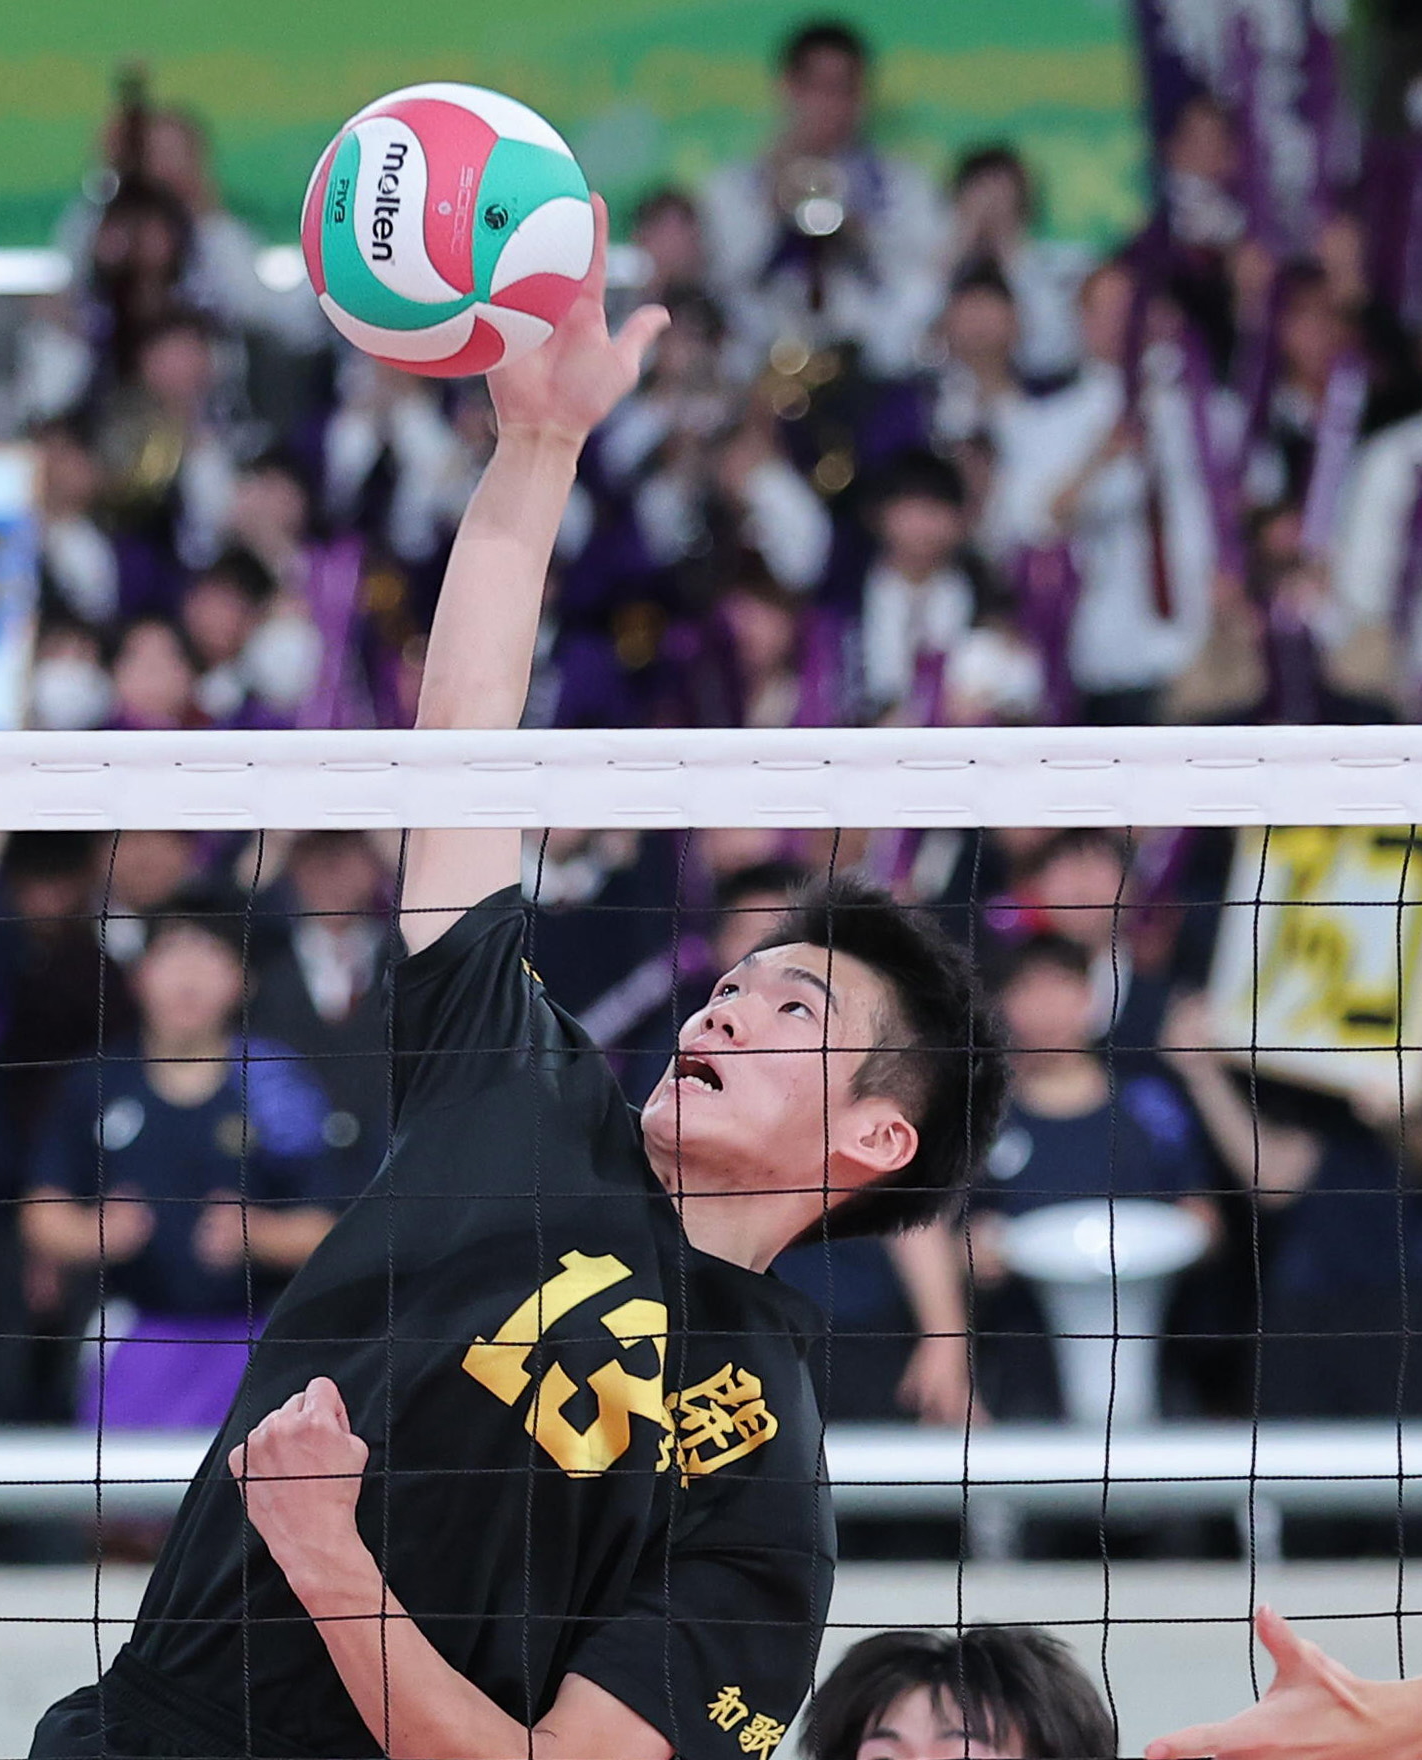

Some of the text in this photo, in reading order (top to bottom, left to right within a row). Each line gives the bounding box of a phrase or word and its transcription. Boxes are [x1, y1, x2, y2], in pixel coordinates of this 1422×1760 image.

[372, 142, 408, 262] molten
[462, 1249, 674, 1478] 13
[655, 1362, 779, 1489] 開
